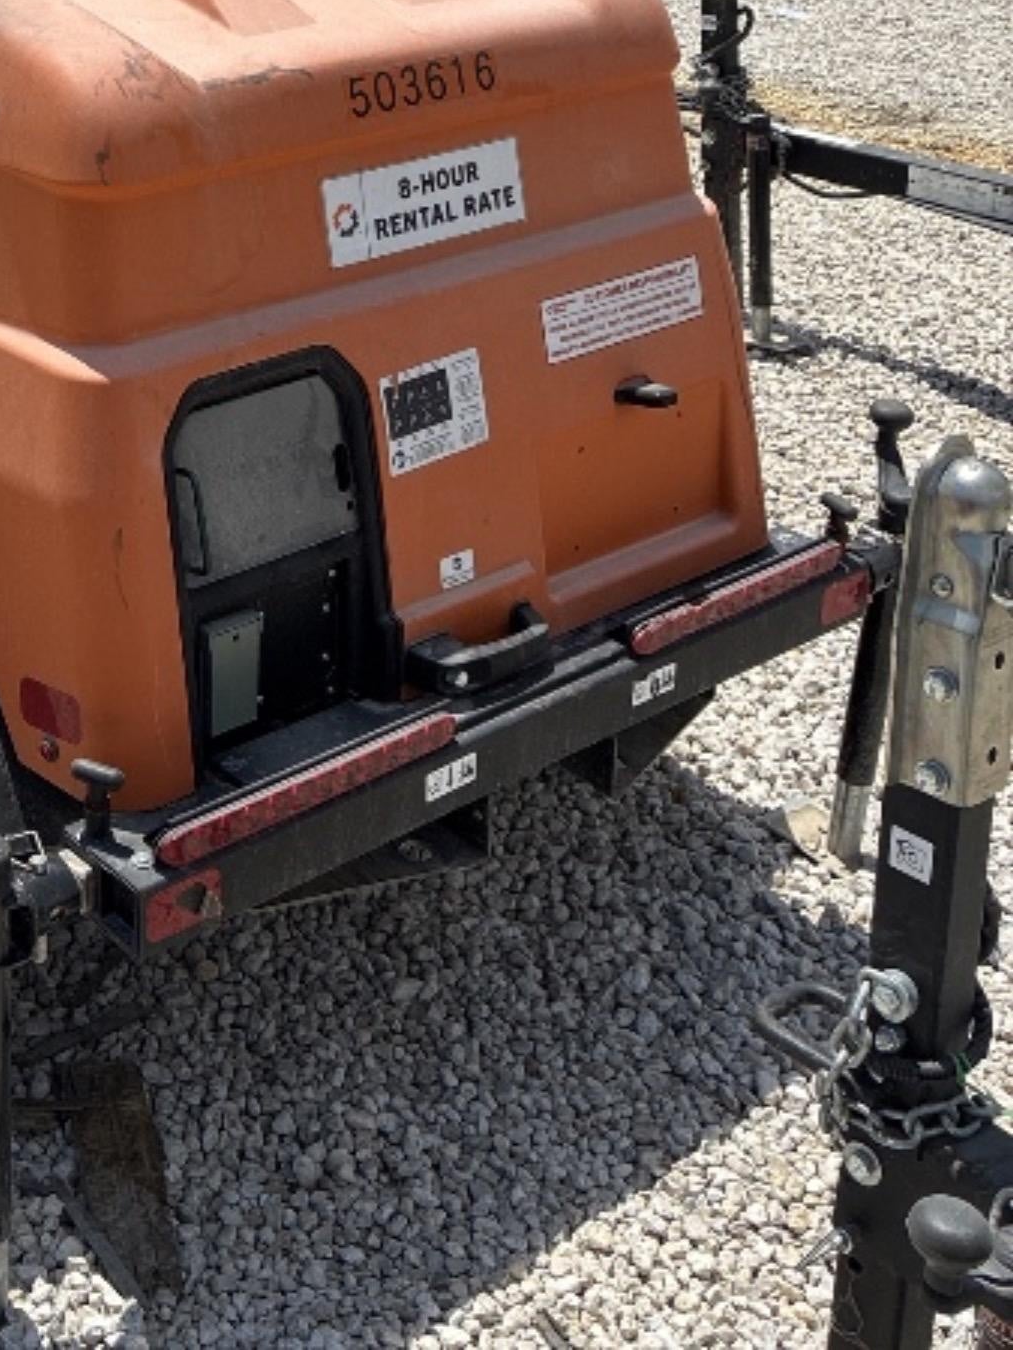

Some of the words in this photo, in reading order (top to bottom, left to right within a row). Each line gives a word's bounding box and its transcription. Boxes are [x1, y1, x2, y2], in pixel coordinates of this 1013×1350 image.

[348, 52, 496, 118] 503616
[397, 162, 480, 199] 8-HOUR
[374, 202, 457, 240] RENTAL
[463, 185, 516, 217] RATE
